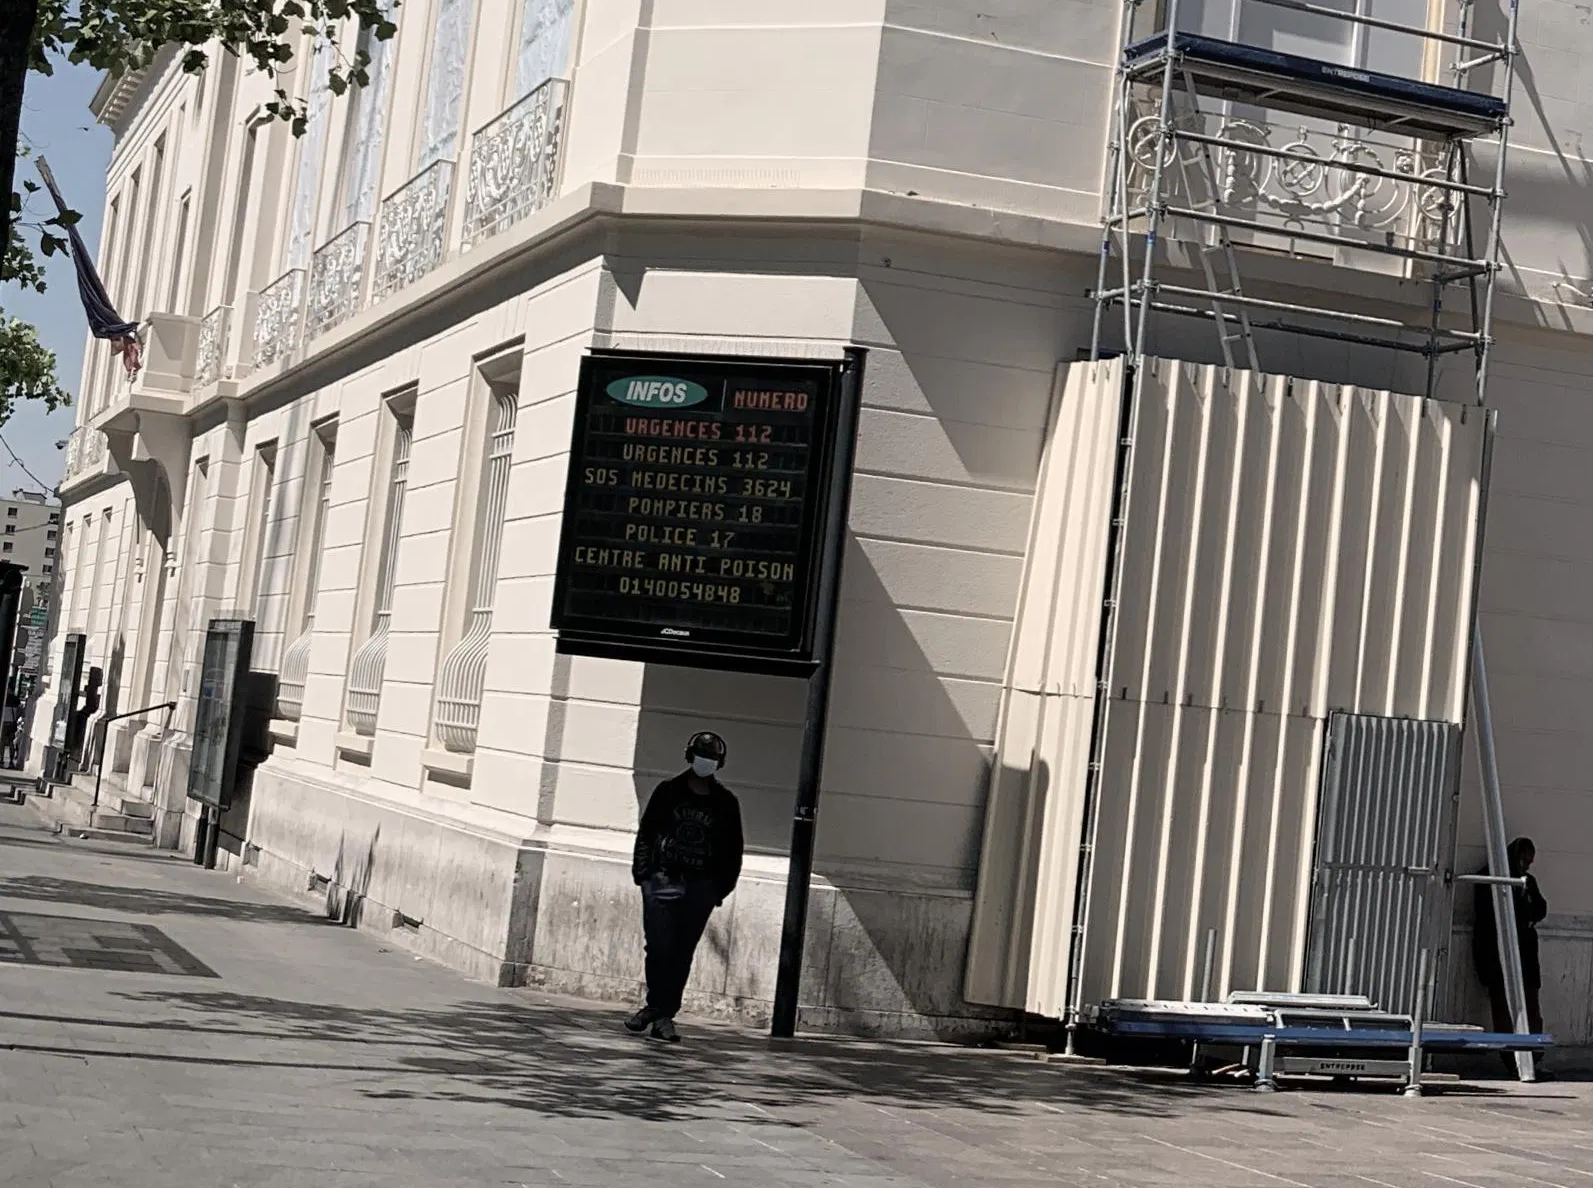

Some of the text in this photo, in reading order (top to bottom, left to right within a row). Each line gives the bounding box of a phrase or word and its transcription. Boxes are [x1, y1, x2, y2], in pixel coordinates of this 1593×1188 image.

[626, 380, 687, 404] INFOS
[733, 389, 808, 410] NUMERO
[626, 417, 772, 443] URGENCES 112
[623, 443, 769, 470] URGENCES 112
[584, 467, 792, 498] SOS MEDECINS 3624
[628, 497, 762, 523] POMPIERS 18
[626, 523, 736, 549] POLICE 17
[575, 546, 794, 581] CENTRE ANTI POISON
[619, 576, 740, 603] 0140054848
